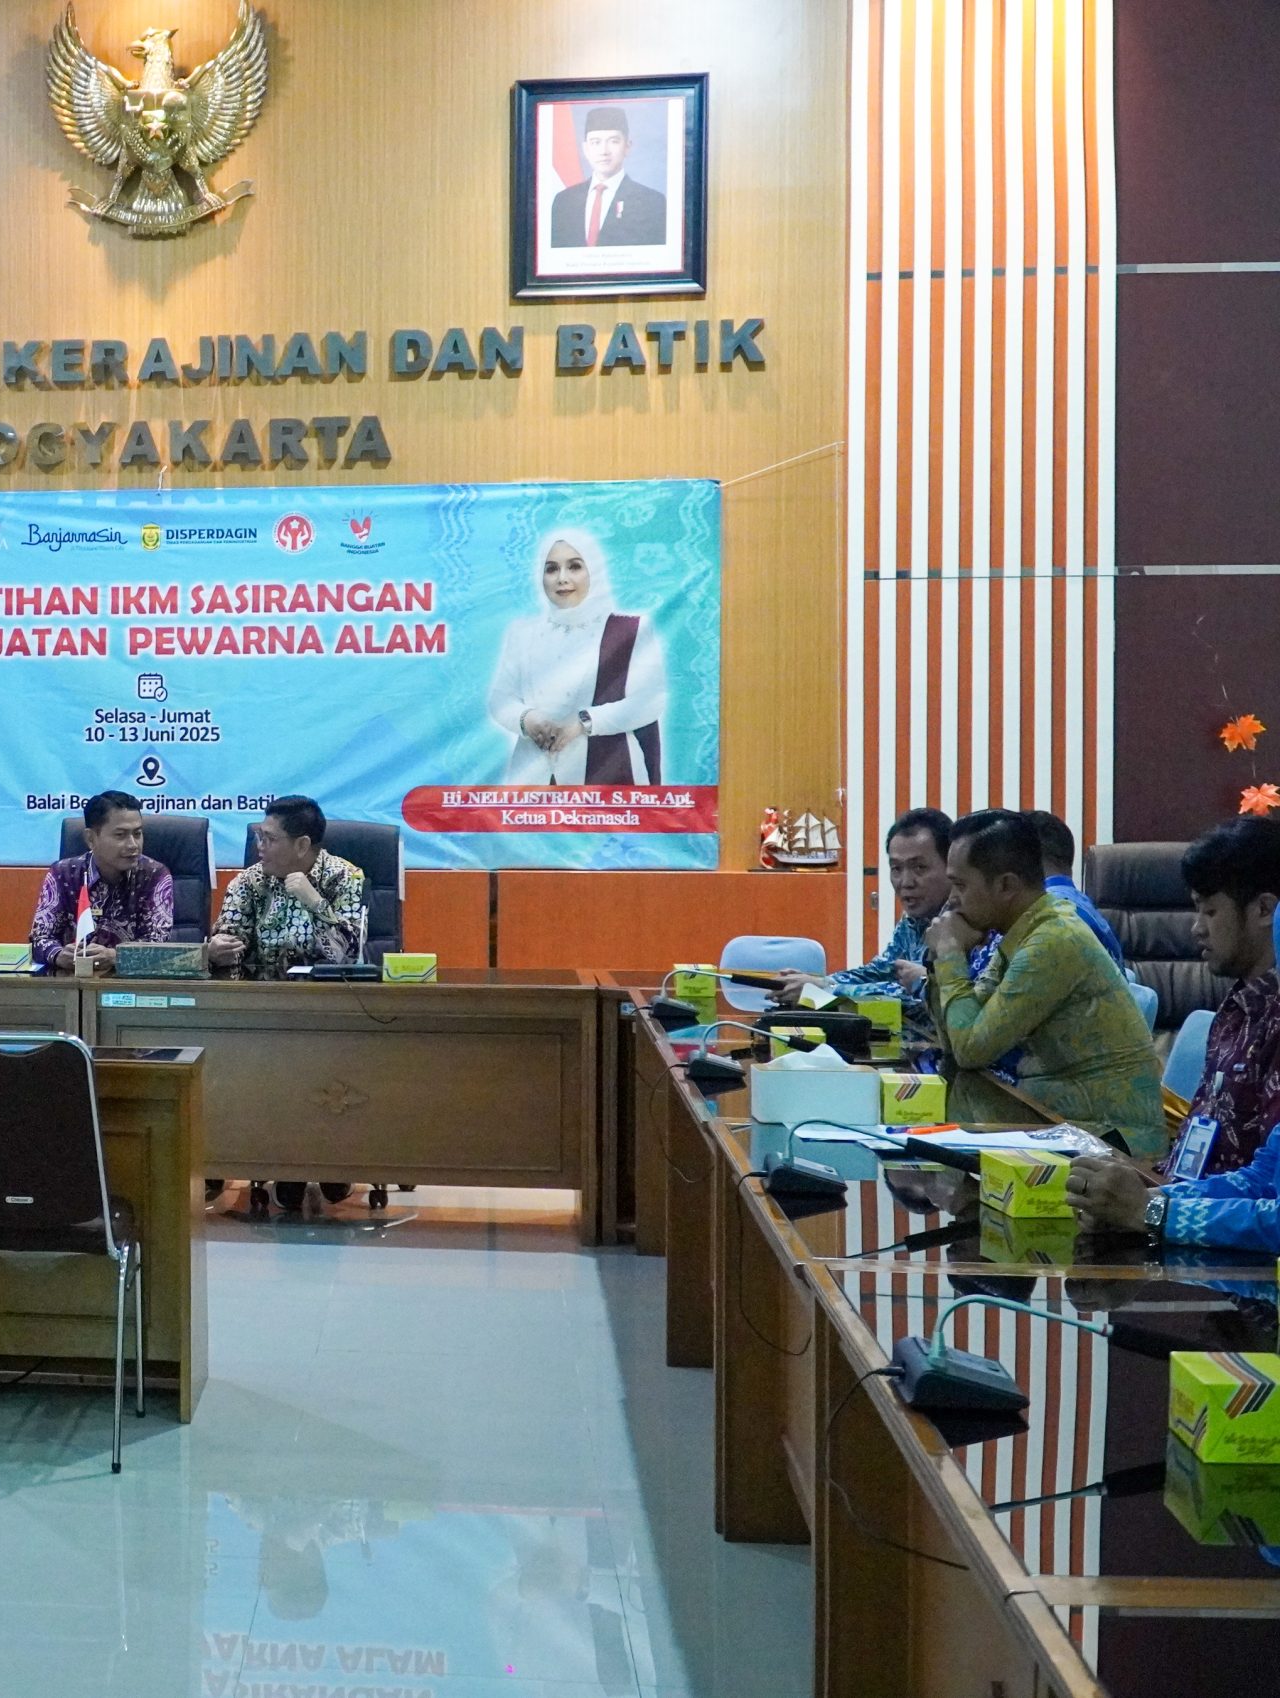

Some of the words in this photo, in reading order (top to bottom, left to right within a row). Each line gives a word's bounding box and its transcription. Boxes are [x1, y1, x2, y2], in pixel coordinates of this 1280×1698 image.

[3, 331, 367, 391] KERAJINAN
[390, 327, 523, 381] DAN
[555, 318, 765, 377] BATIK
[166, 528, 257, 540] DISPERDAGIN
[111, 586, 179, 614] IKM
[190, 582, 434, 614] SASIRANGAN
[129, 625, 323, 656] PEWARNA
[335, 623, 447, 654] ALAM
[95, 708, 147, 725] Selasa
[159, 708, 211, 726] Jumat
[85, 727, 104, 742] 10
[119, 727, 138, 742] 13
[142, 726, 175, 745] Juni
[179, 727, 220, 742] 2025
[27, 795, 65, 810] Balai
[141, 795, 197, 813] rajinan
[201, 795, 232, 810] dan
[469, 792, 510, 804] NELI
[612, 792, 626, 804] S.
[663, 792, 695, 807] Apt.
[502, 810, 546, 825] Ketua
[551, 810, 640, 825] Dekranasda
